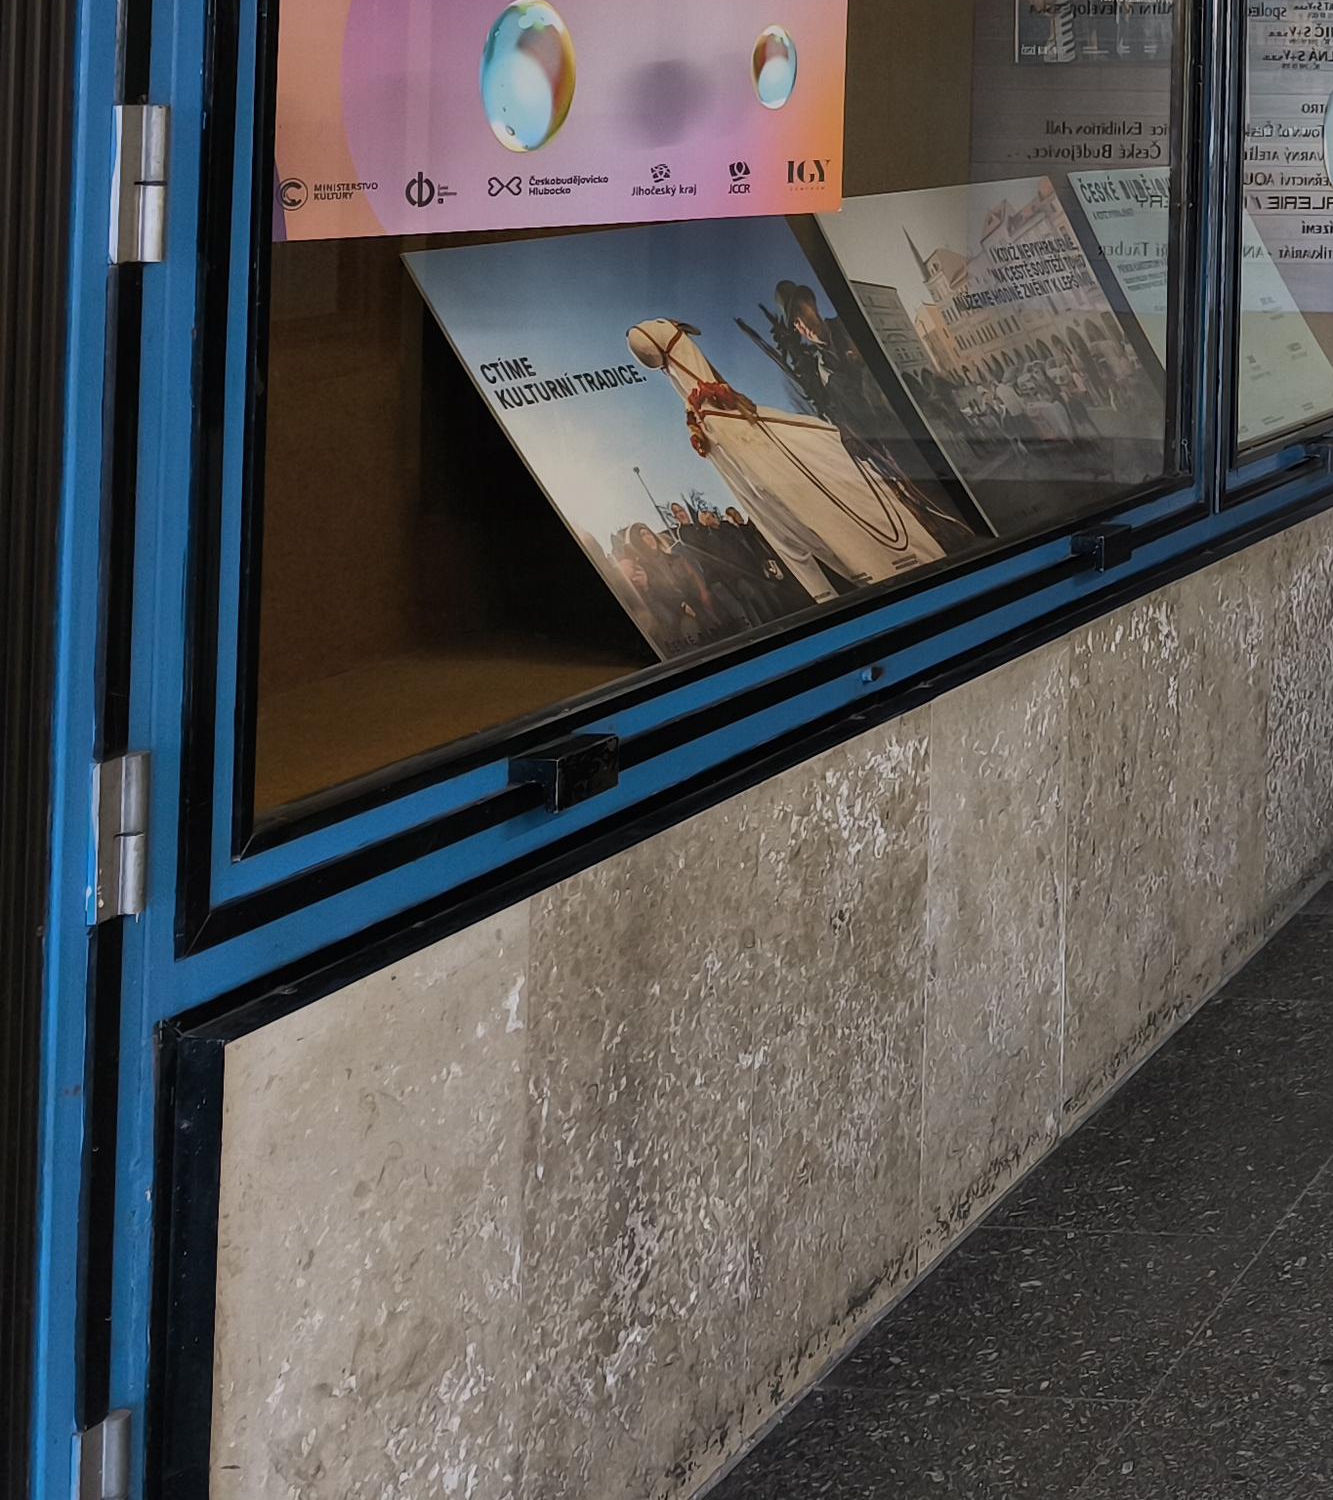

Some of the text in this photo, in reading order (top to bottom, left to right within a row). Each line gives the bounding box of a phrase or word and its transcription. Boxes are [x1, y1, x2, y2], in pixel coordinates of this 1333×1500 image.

[787, 159, 832, 184] IGY
[314, 181, 379, 192] MINISTERSTVO
[528, 174, 609, 187] Českobudějovicko
[528, 186, 571, 196] Hlubocko
[631, 183, 697, 197] Jihočeský kraj
[728, 184, 751, 194] JCCR
[314, 192, 354, 201] KULTURY
[480, 357, 537, 384] CTÍME
[494, 364, 648, 410] KULTURNÍ TRADICE.
